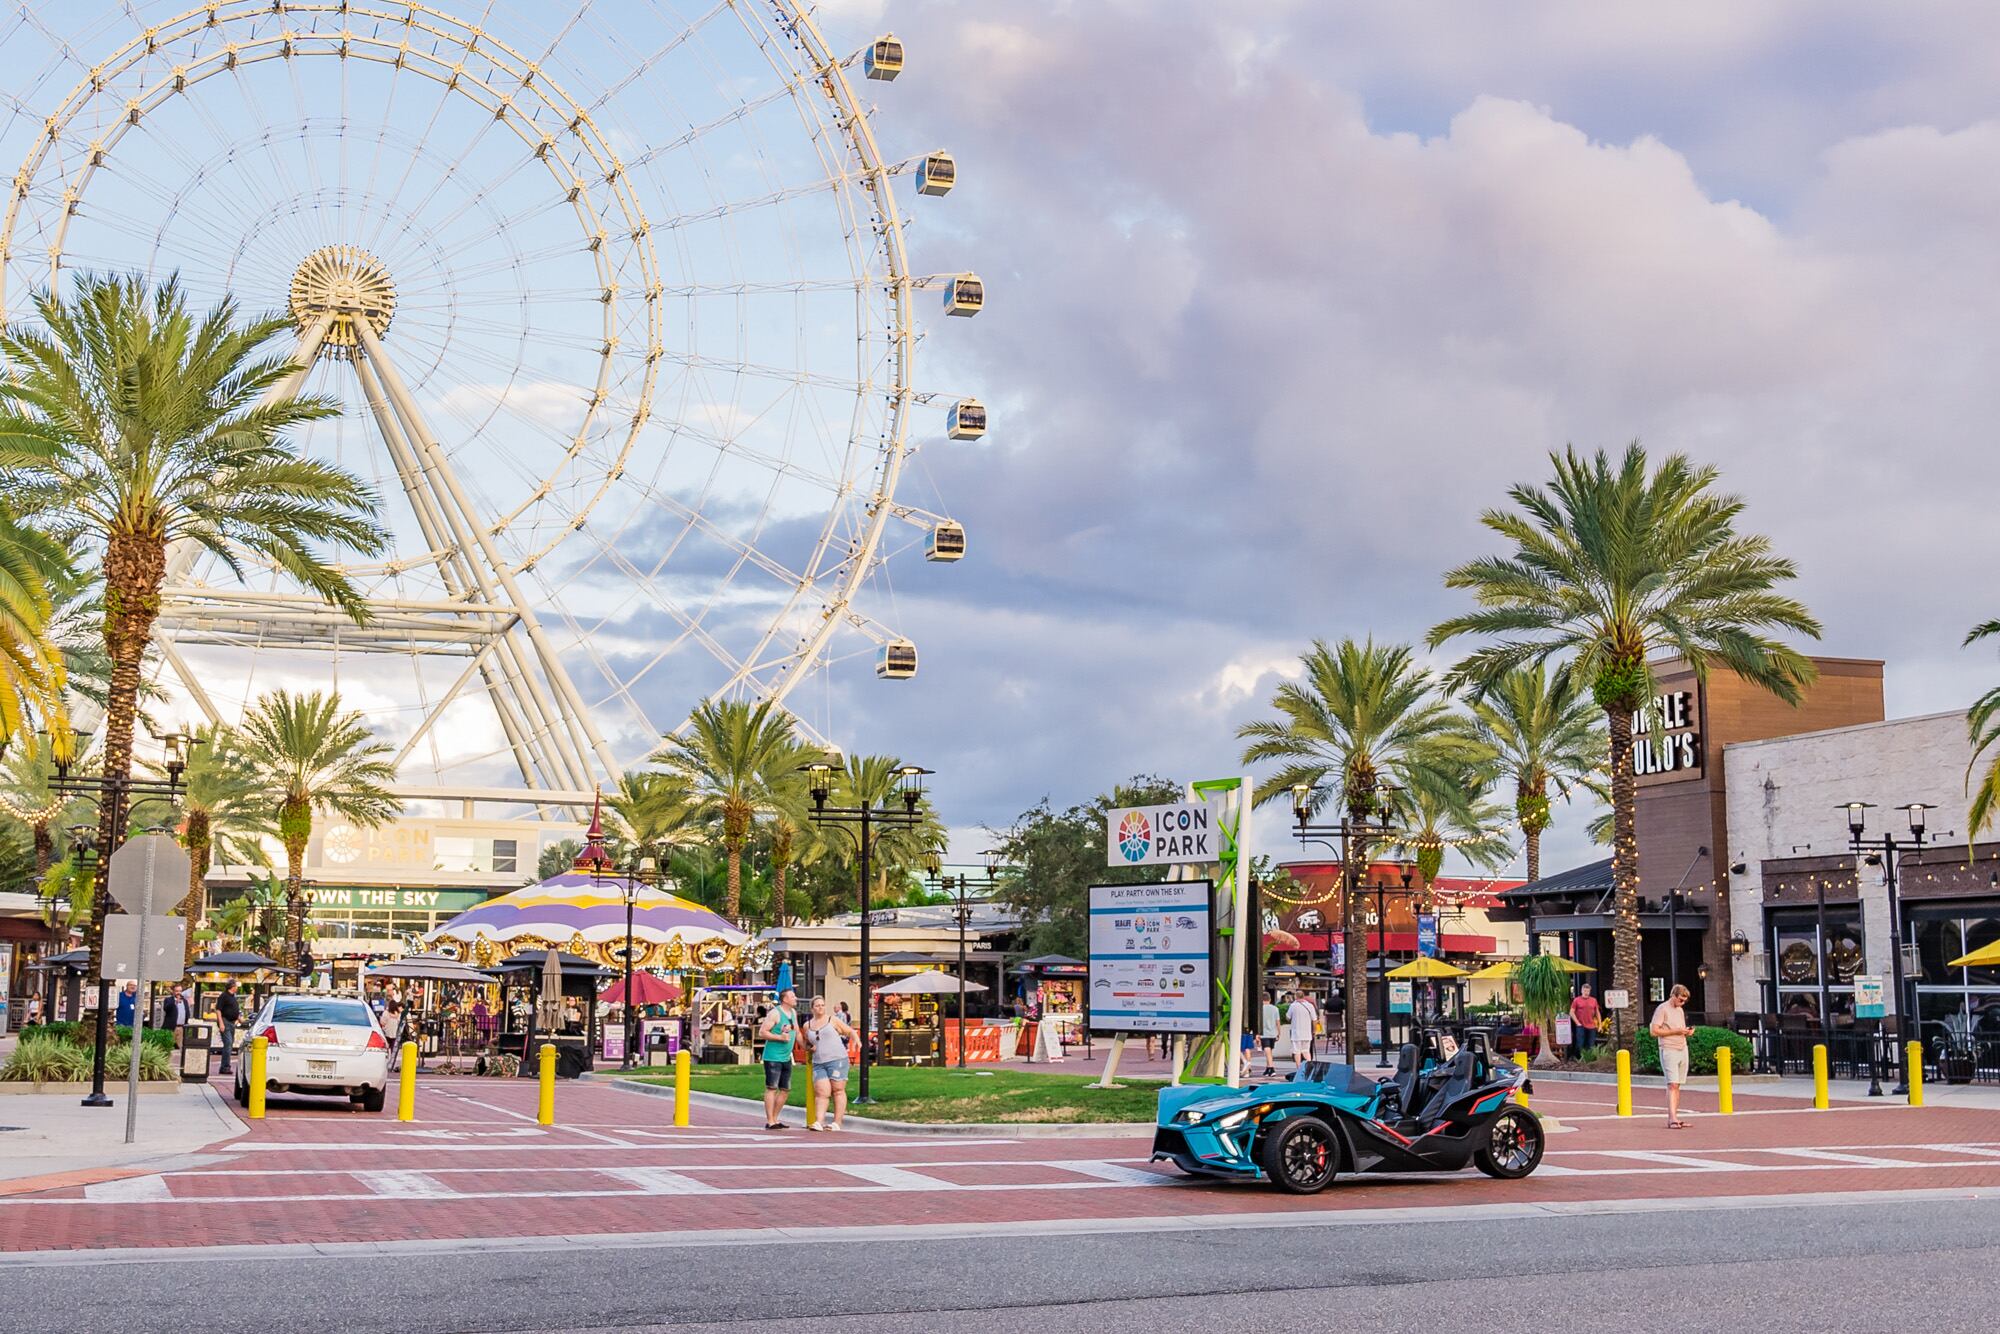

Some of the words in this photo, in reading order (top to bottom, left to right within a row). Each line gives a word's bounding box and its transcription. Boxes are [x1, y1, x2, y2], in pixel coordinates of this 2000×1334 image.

[1633, 732, 1694, 775] ULIO'S
[1155, 808, 1208, 833] ICON
[368, 828, 430, 845] ICON
[1156, 834, 1208, 857] PARK
[368, 847, 427, 863] PARK
[303, 889, 351, 904] OWN
[359, 890, 396, 906] THE
[403, 890, 440, 906] SKY
[1145, 888, 1160, 896] OWN
[1160, 888, 1173, 896] THE
[972, 942, 992, 950] PARIS
